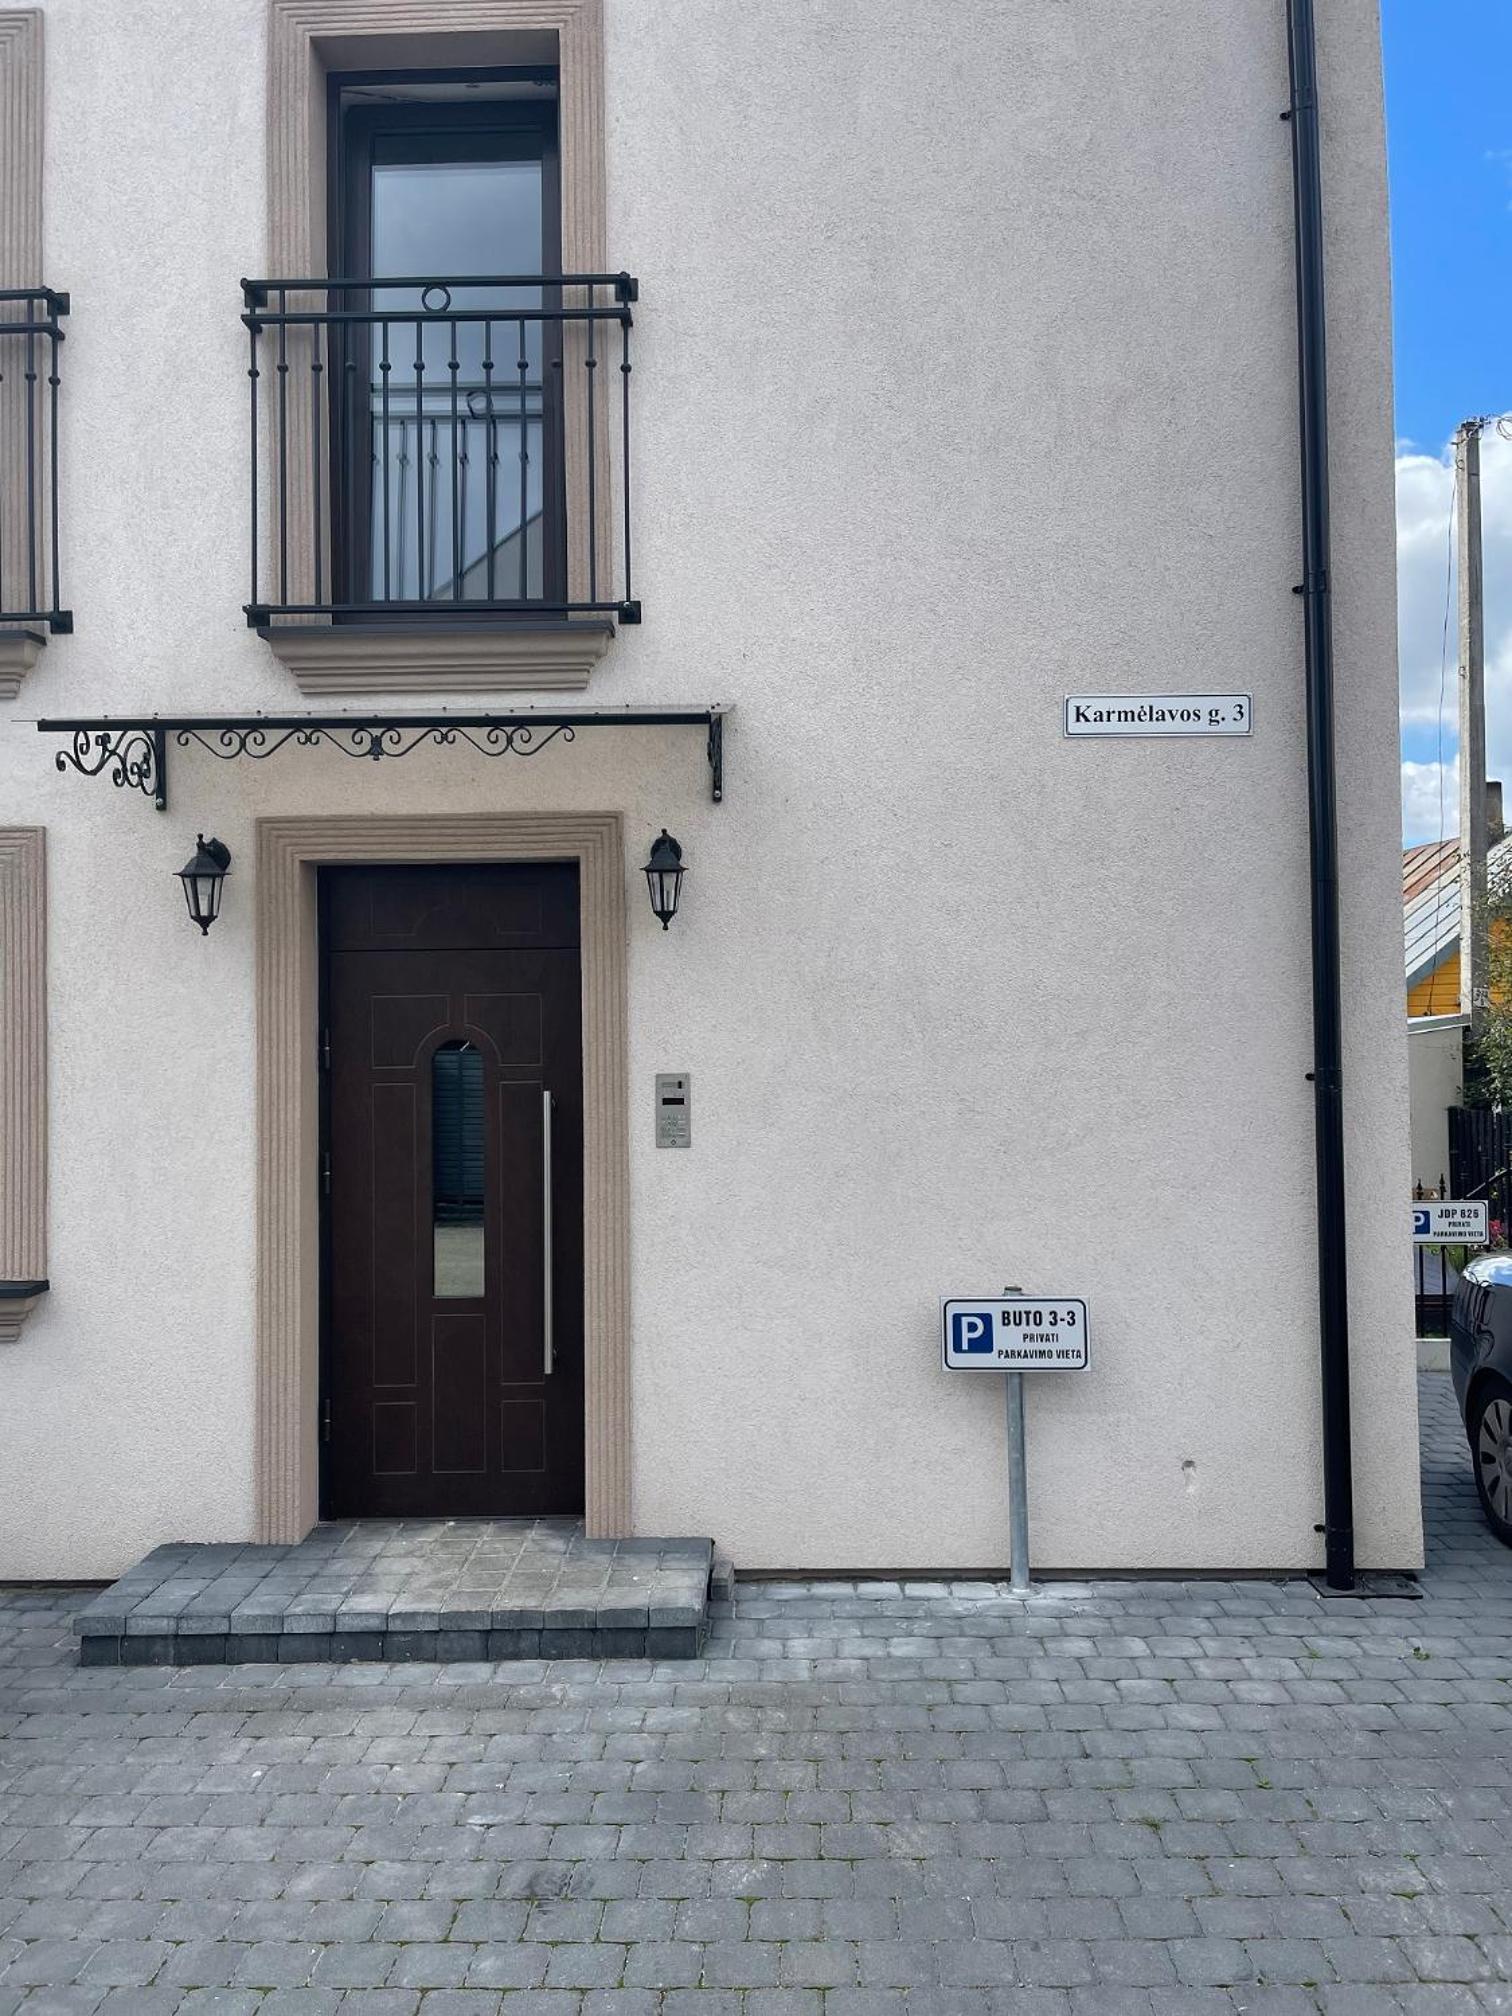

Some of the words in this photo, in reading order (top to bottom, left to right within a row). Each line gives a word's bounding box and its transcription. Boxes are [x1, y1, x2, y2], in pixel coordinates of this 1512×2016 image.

[1074, 705, 1201, 723] Karmėlavos
[1208, 708, 1226, 726] g.
[1232, 704, 1244, 721] 3
[1001, 1310, 1043, 1327] BUTO
[1049, 1310, 1076, 1327] 3-3
[961, 1316, 984, 1350] P
[1022, 1333, 1059, 1343] PRIVATI
[998, 1349, 1053, 1359] PARKAVIMO
[1056, 1349, 1082, 1359] VIETA
